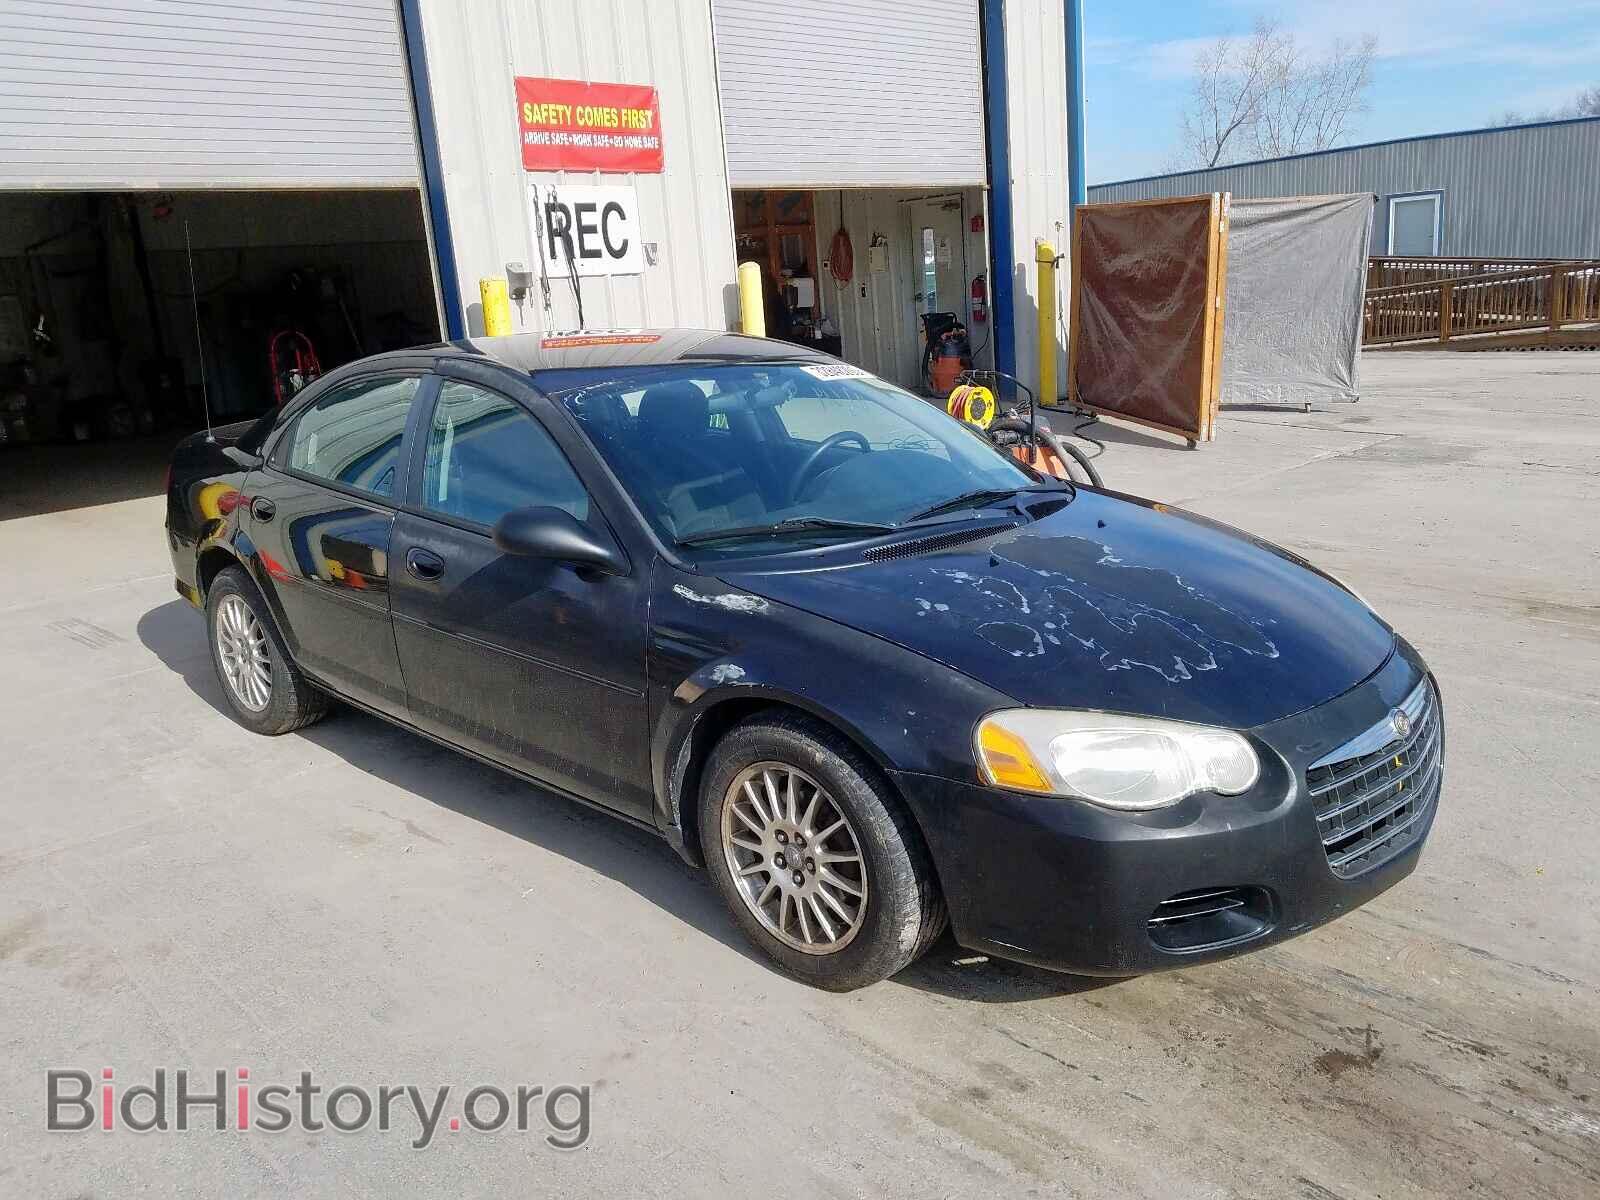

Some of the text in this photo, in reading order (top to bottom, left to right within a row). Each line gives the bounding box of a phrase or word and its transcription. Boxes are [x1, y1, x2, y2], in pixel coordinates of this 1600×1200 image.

[523, 102, 653, 128] SAFETY COMES FIRST
[524, 131, 550, 145] ARRIVE
[551, 132, 569, 145] SAFE
[544, 201, 629, 260] REC
